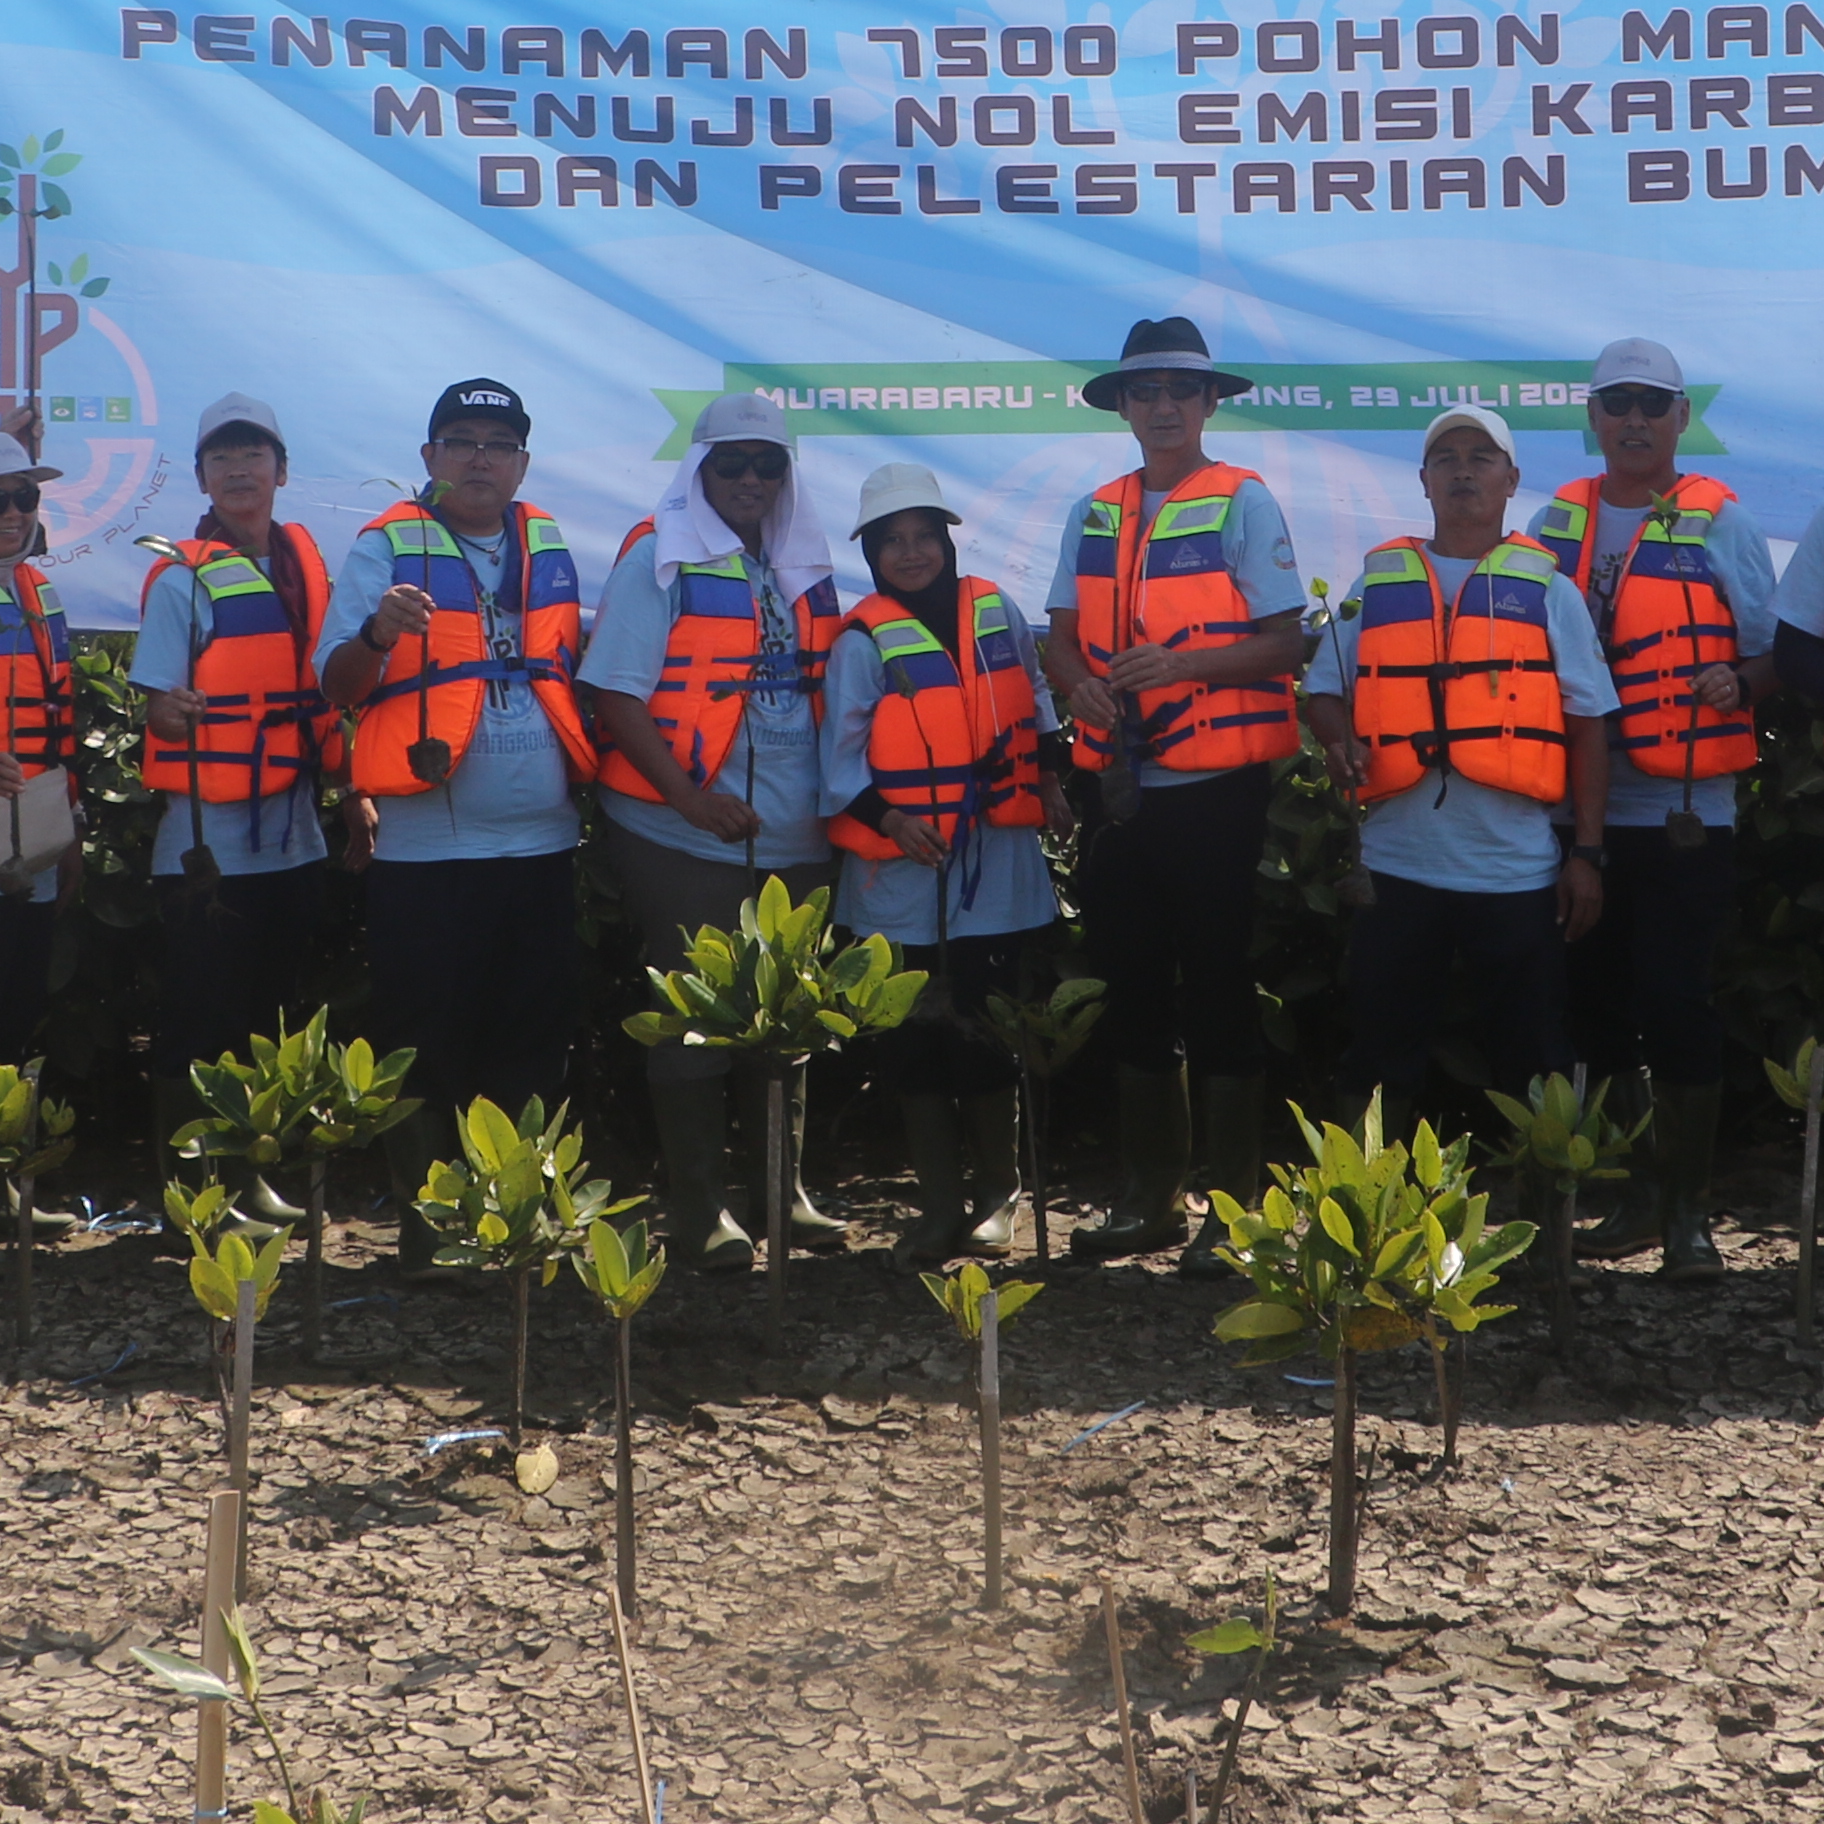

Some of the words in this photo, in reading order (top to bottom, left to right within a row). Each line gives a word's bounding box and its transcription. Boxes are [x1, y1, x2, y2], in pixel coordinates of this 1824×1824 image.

[119, 6, 809, 81] PENANAMAN
[866, 24, 1117, 79] 7500
[1176, 10, 1562, 76] POHON
[373, 84, 834, 148] MENUJU
[893, 93, 1116, 148] NOL
[1176, 83, 1473, 145] EMISI
[477, 153, 698, 209] DAN
[758, 151, 1568, 216] PELESTARIAN
[459, 389, 511, 408] VANS
[754, 385, 1033, 411] MUARABARU
[1349, 386, 1400, 408] 29
[1409, 383, 1511, 408] JULI
[1518, 382, 1589, 406] 202
[101, 452, 171, 545] PLANET
